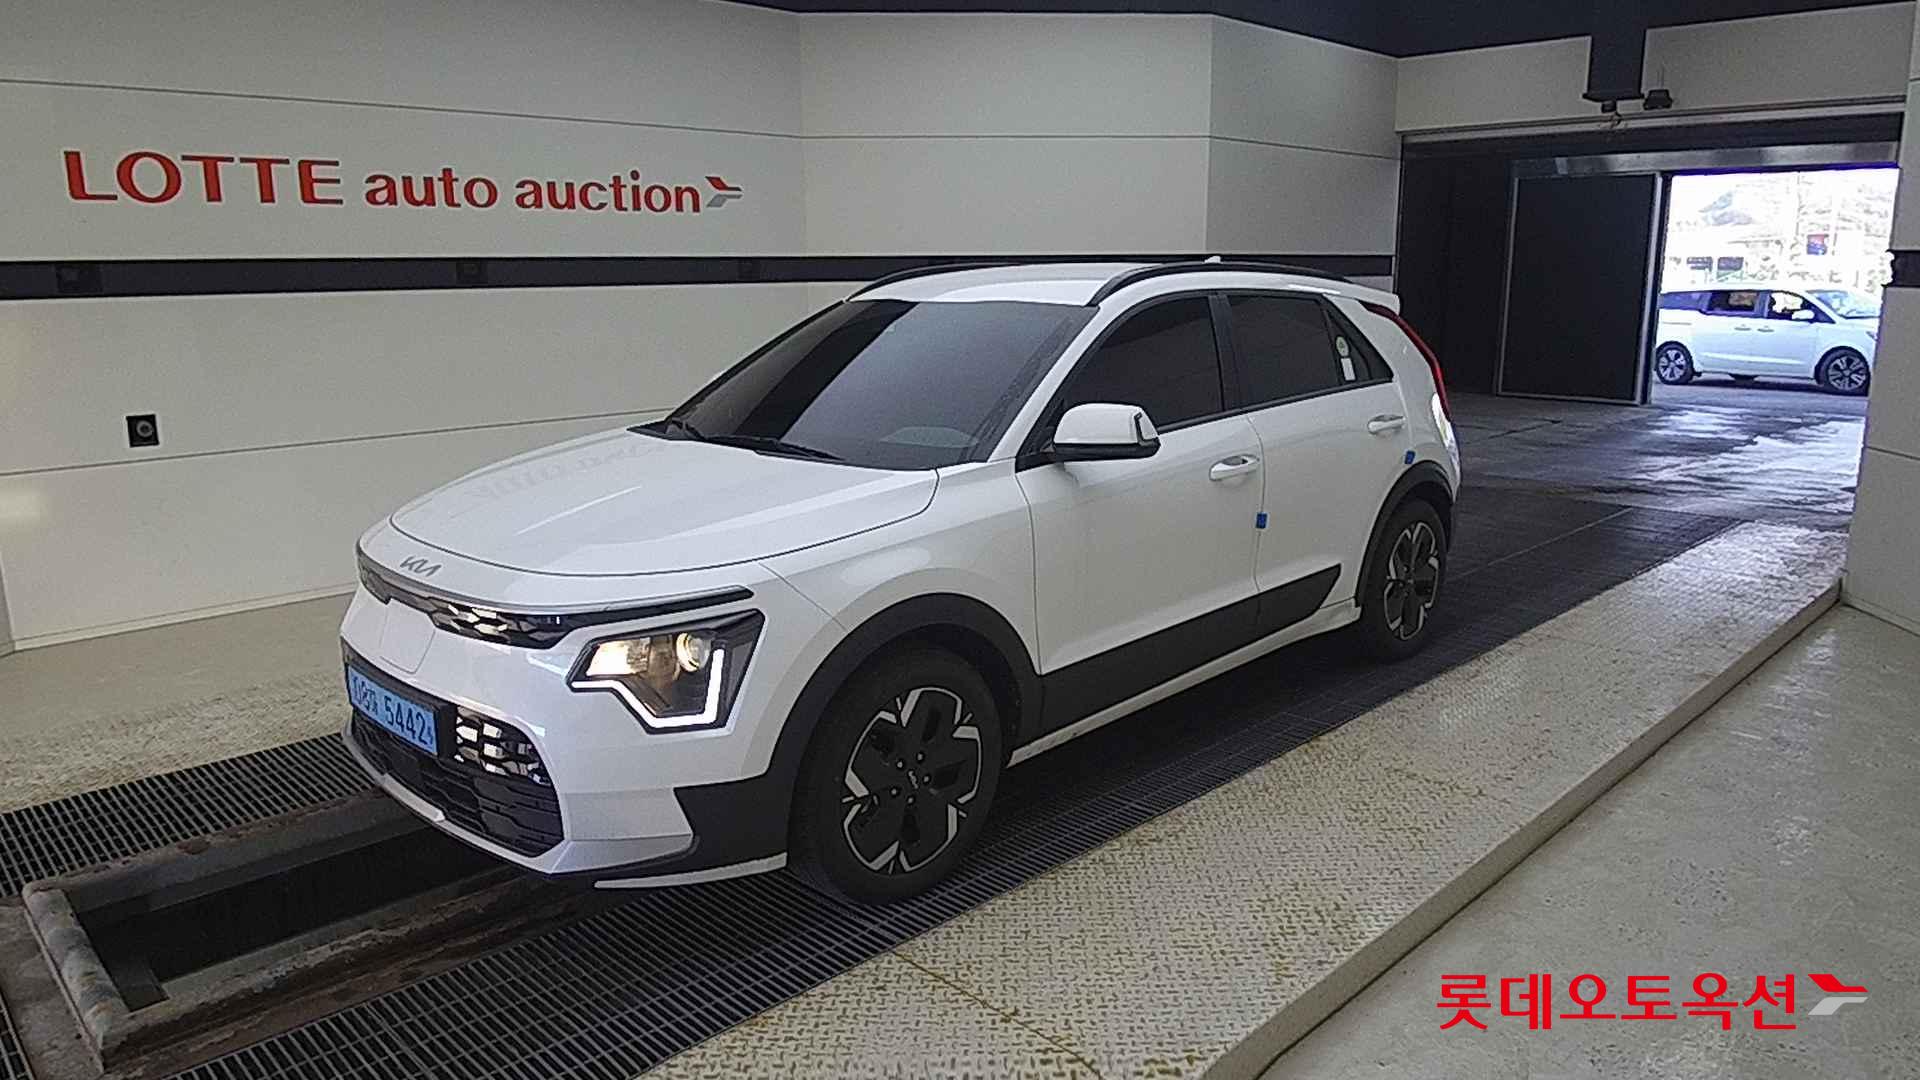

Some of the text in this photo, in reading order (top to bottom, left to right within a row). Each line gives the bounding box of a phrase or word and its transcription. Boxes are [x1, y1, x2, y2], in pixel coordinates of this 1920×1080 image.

[63, 150, 700, 214] LOTTE auto auction
[400, 555, 442, 577] KIA
[384, 694, 428, 745] 5442
